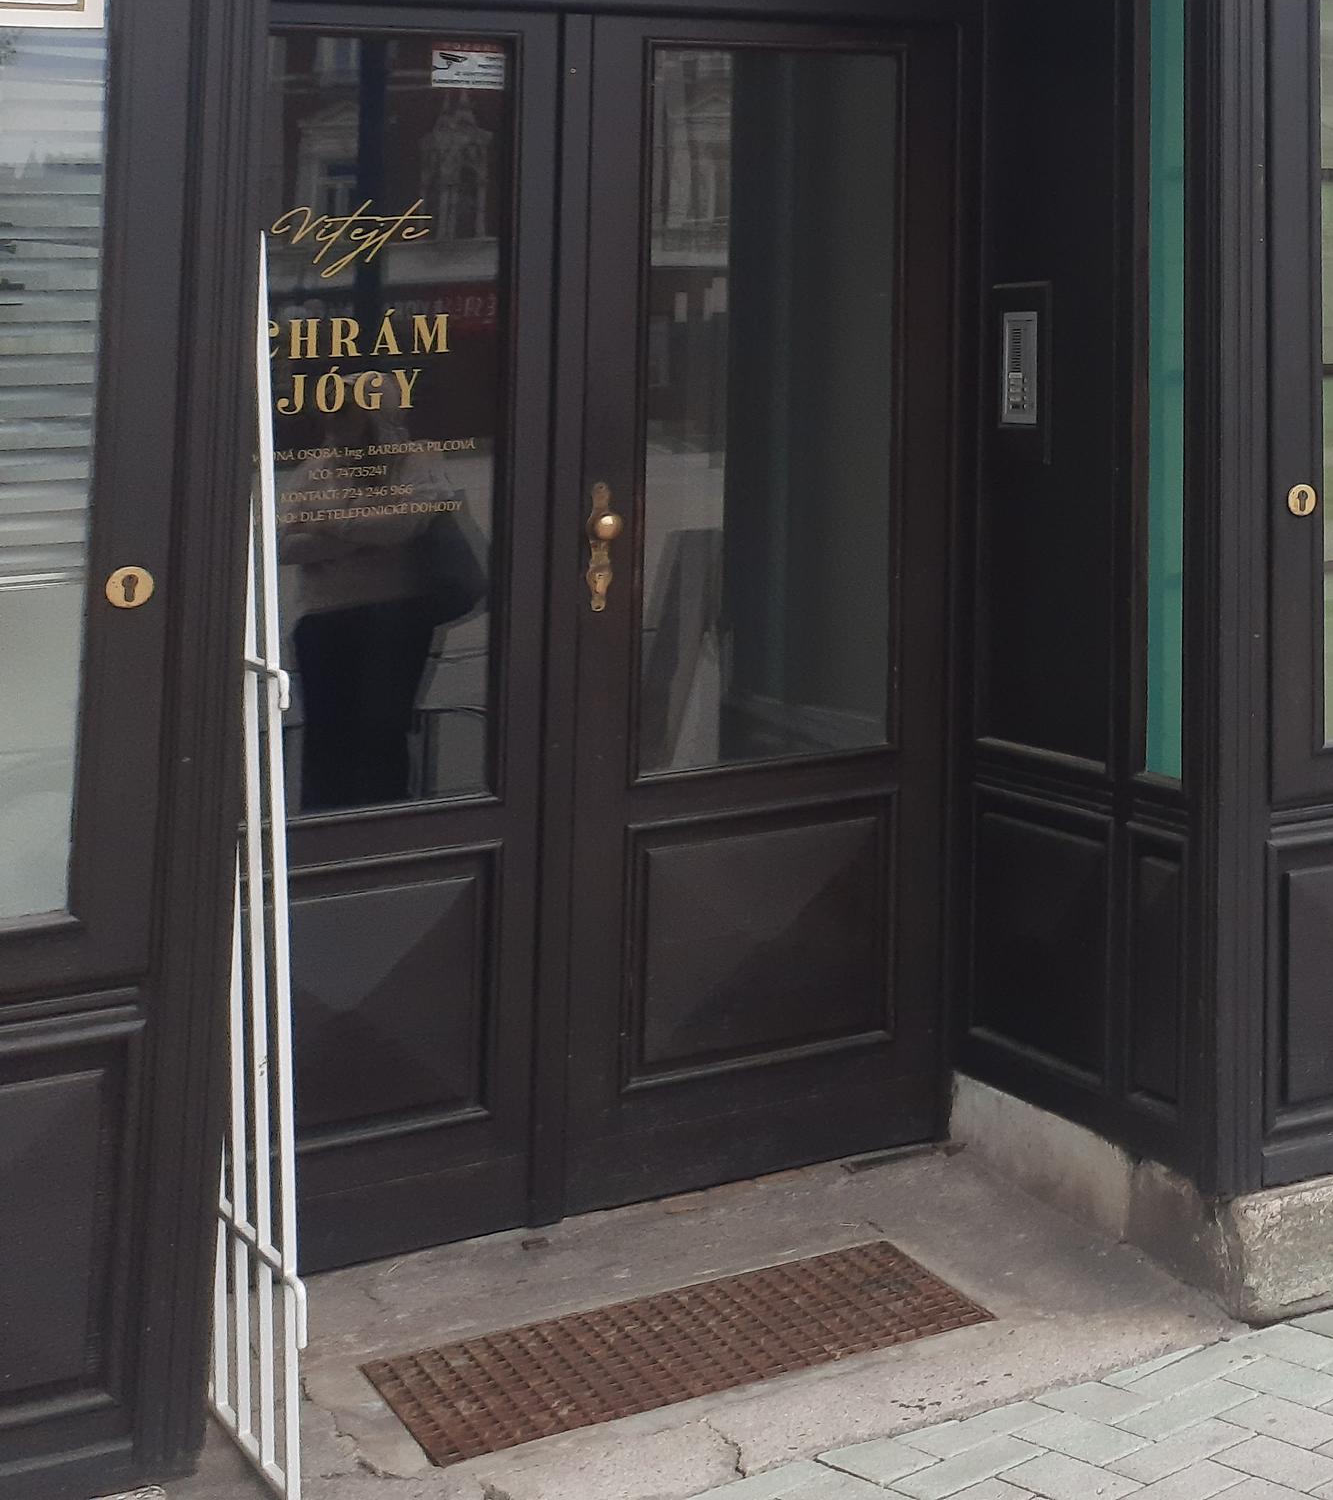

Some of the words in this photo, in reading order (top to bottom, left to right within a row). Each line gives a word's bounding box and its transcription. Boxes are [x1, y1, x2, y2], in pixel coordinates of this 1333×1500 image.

[276, 366, 422, 415] JÓGY
[367, 442, 422, 457] BARBORA
[427, 437, 476, 451] PILCOVÁ
[411, 500, 463, 514] DOHODY
